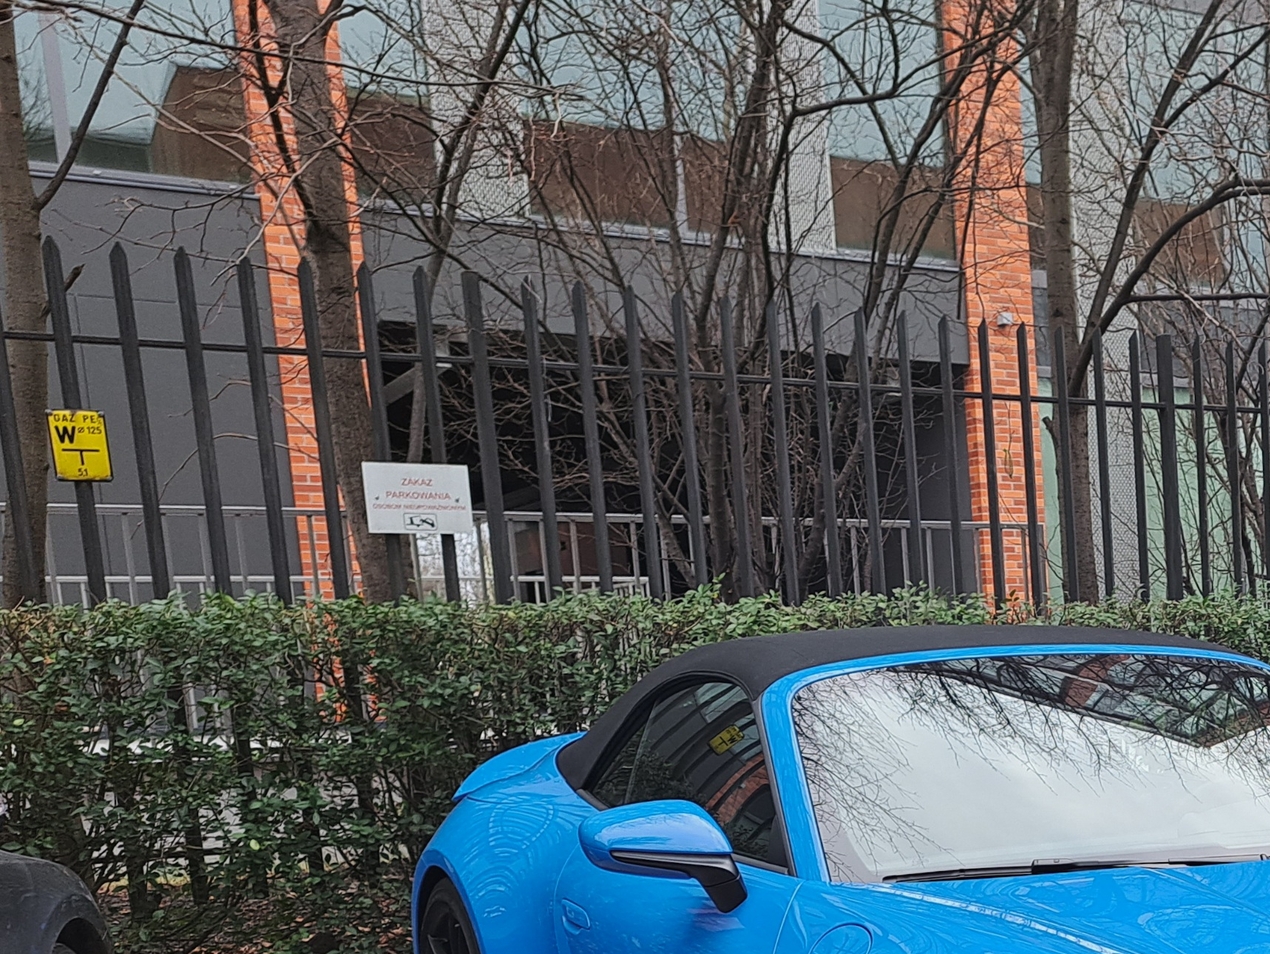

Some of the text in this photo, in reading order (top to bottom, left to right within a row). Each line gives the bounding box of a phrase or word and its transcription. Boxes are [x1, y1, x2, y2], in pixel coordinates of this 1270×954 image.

[54, 425, 76, 444] W
[401, 478, 434, 487] ZAKAZ
[385, 490, 451, 501] PARKOWANIA
